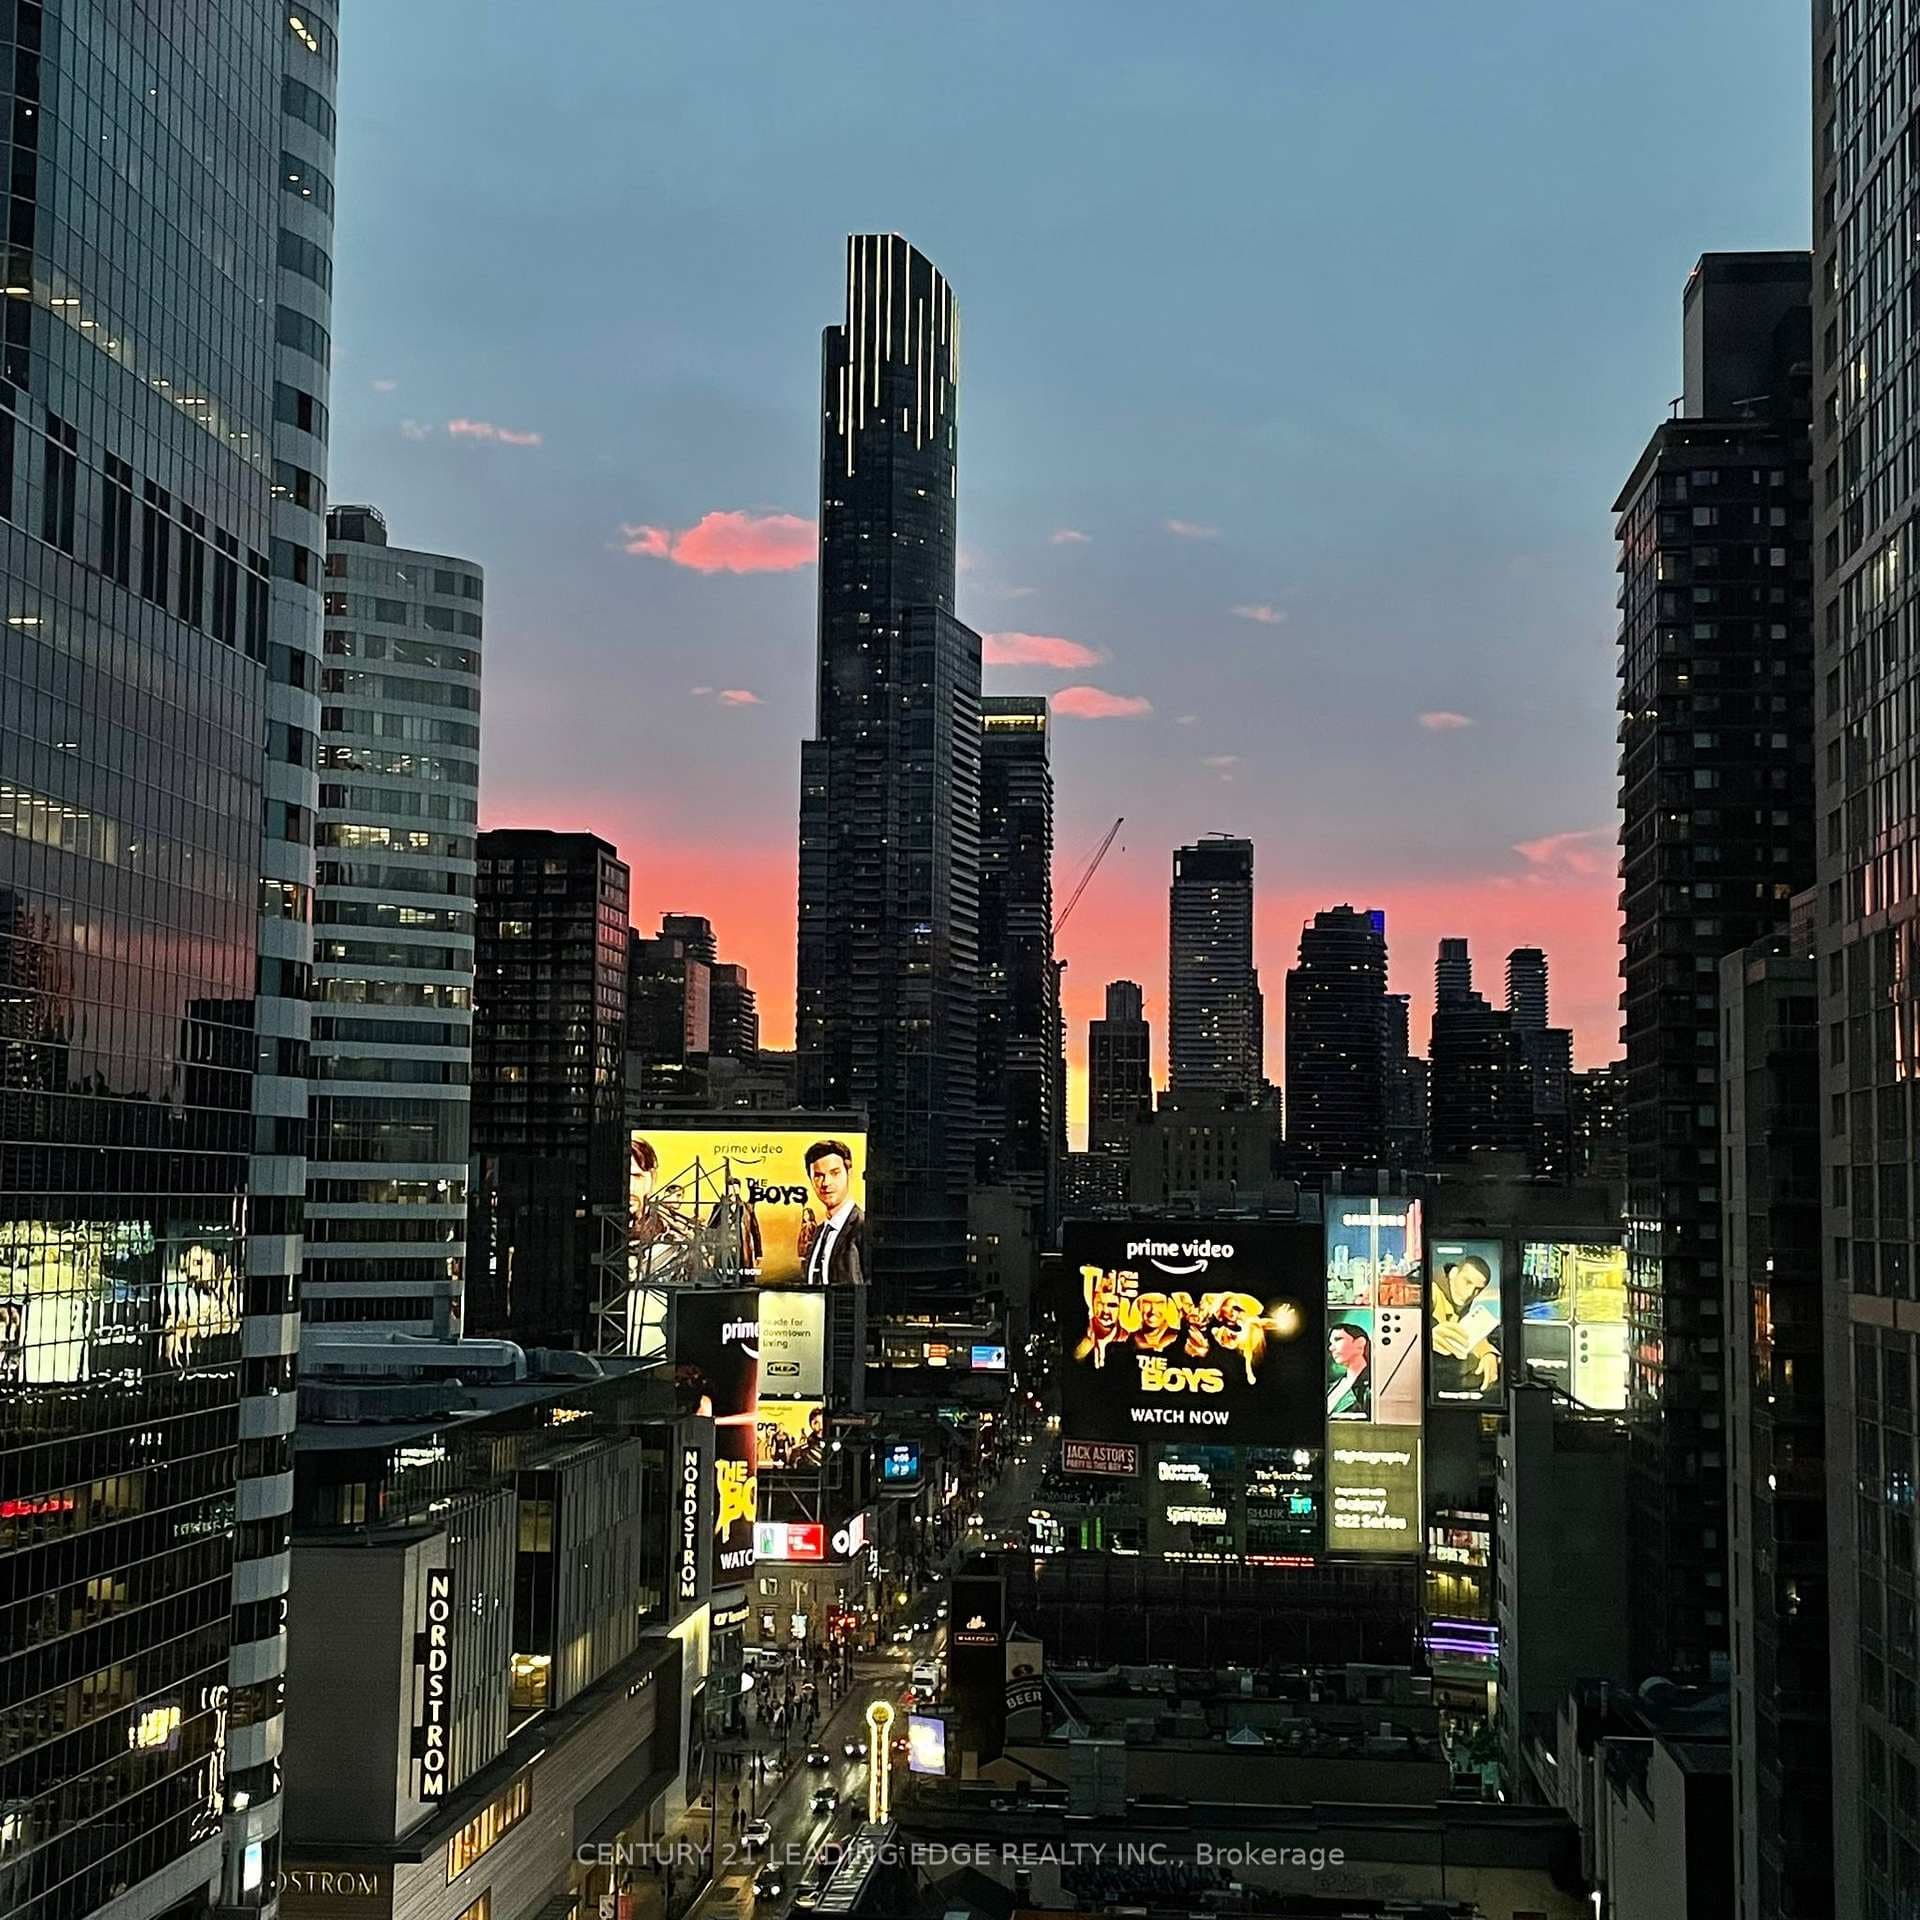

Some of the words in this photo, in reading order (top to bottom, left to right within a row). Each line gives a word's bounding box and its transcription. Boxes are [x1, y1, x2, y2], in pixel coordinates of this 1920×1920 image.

[714, 1145, 748, 1155] prime
[751, 1144, 783, 1154] video
[747, 1186, 808, 1205] BOYS
[1127, 1239, 1179, 1259] prime
[1182, 1240, 1235, 1258] video
[1136, 1355, 1168, 1370] THE
[1141, 1367, 1225, 1393] BOYS
[1131, 1408, 1184, 1424] WATCH
[1190, 1410, 1230, 1425] NOW
[1067, 1445, 1090, 1460] JACK
[1093, 1447, 1134, 1463] ASTOR'S
[715, 1459, 748, 1482] THE
[681, 1451, 698, 1598] NORDSTROM
[720, 1548, 755, 1570] WATC
[424, 1576, 449, 1796] NORDSTROM
[1006, 1691, 1042, 1709] BEER
